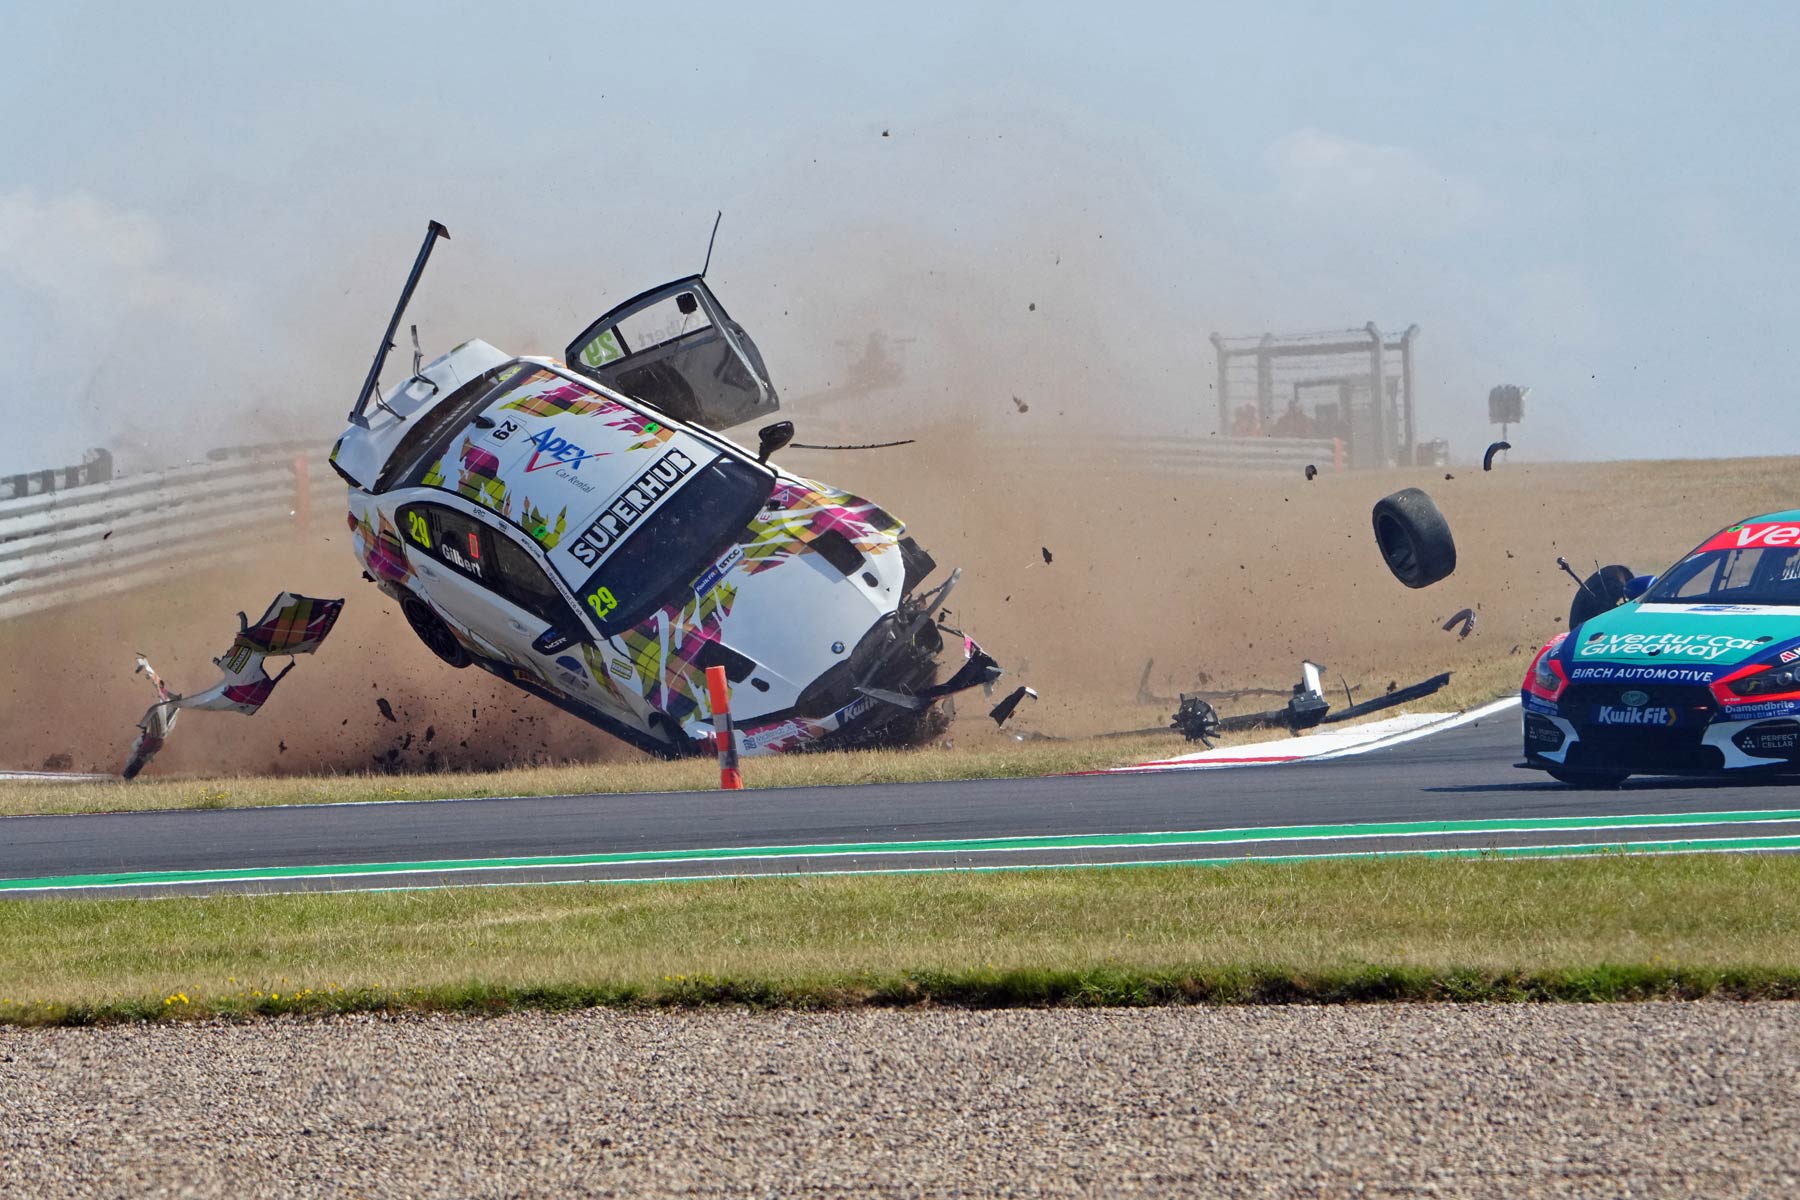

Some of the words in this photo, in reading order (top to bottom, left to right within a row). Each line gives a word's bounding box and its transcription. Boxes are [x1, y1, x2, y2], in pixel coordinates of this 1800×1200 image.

[492, 420, 518, 440] 29
[521, 427, 598, 471] APEX
[555, 468, 570, 480] Car
[568, 475, 596, 494] Rental
[572, 450, 693, 564] SUPERHUB
[408, 511, 431, 549] 29
[1736, 525, 1800, 546] ve
[441, 543, 482, 578] Gilbert
[718, 548, 740, 569] BTCC
[587, 586, 618, 618] 29
[1571, 667, 1615, 679] BIRCH
[1615, 668, 1714, 682] AUTOMOTIVE
[1725, 700, 1796, 714] Diamondbrite
[1761, 733, 1799, 741] PERFECT
[1761, 741, 1793, 749] CELLAR
